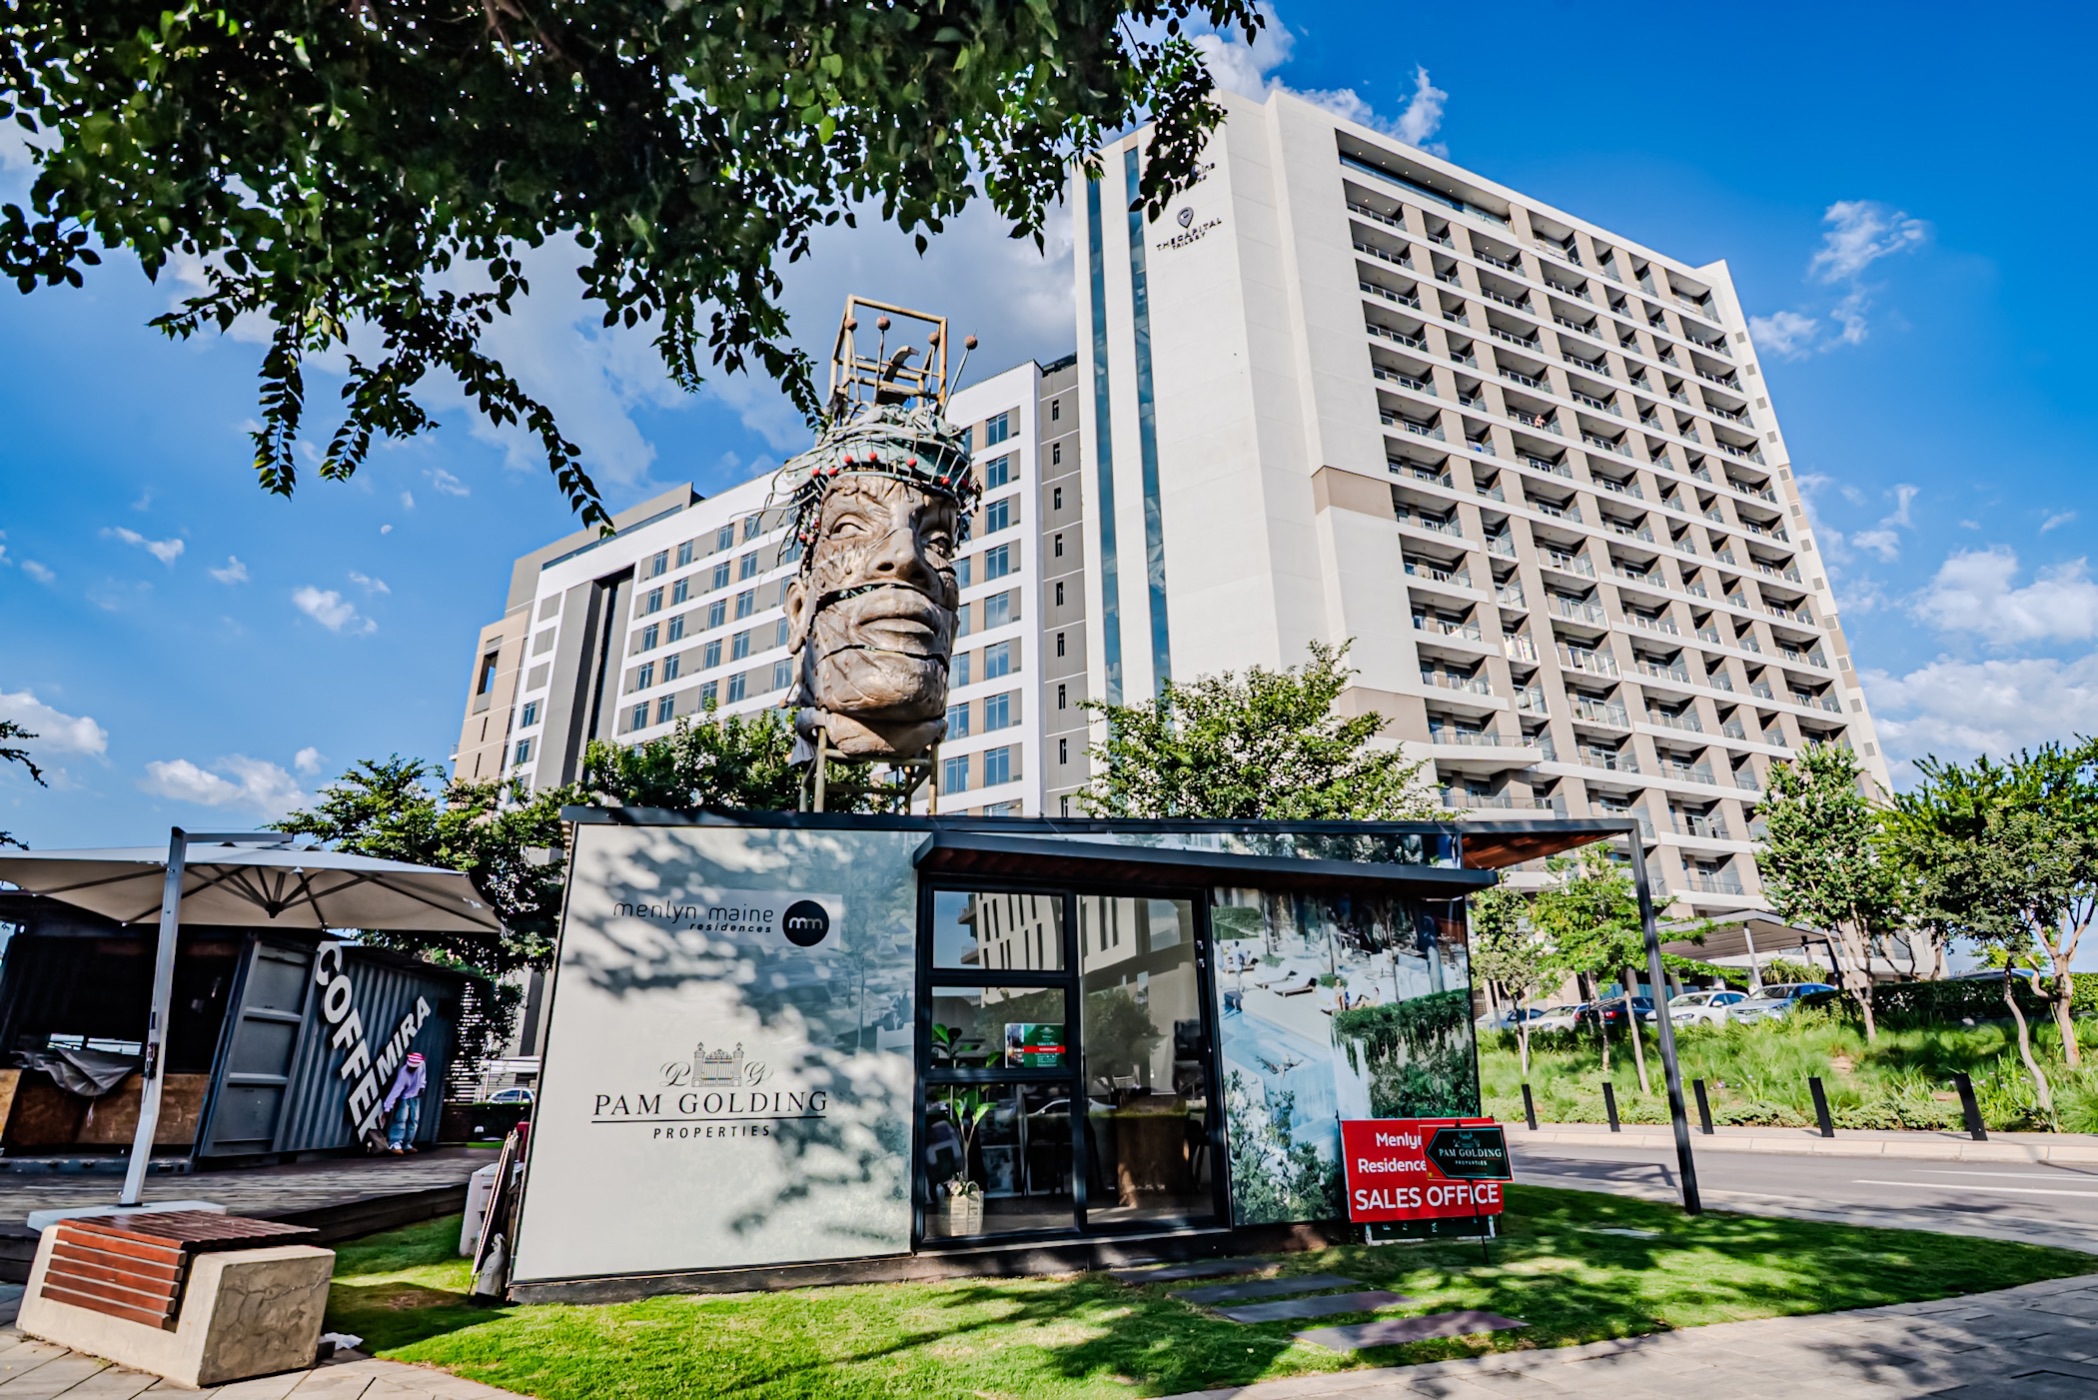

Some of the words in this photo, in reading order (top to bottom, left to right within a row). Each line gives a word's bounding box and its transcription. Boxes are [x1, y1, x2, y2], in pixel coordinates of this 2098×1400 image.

[1177, 217, 1222, 242] CAPITAL
[613, 900, 697, 924] menlyn
[708, 903, 774, 923] maine
[689, 922, 772, 934] residences
[375, 996, 432, 1086] MIRA
[592, 1093, 663, 1116] PAM
[678, 1090, 828, 1115] GOLDING
[653, 1125, 771, 1139] PROPERTIES
[1438, 1148, 1457, 1158] PAM
[1458, 1148, 1503, 1158] GOLDING
[1355, 1186, 1421, 1211] SALES
[1426, 1183, 1500, 1207] OFFICE
